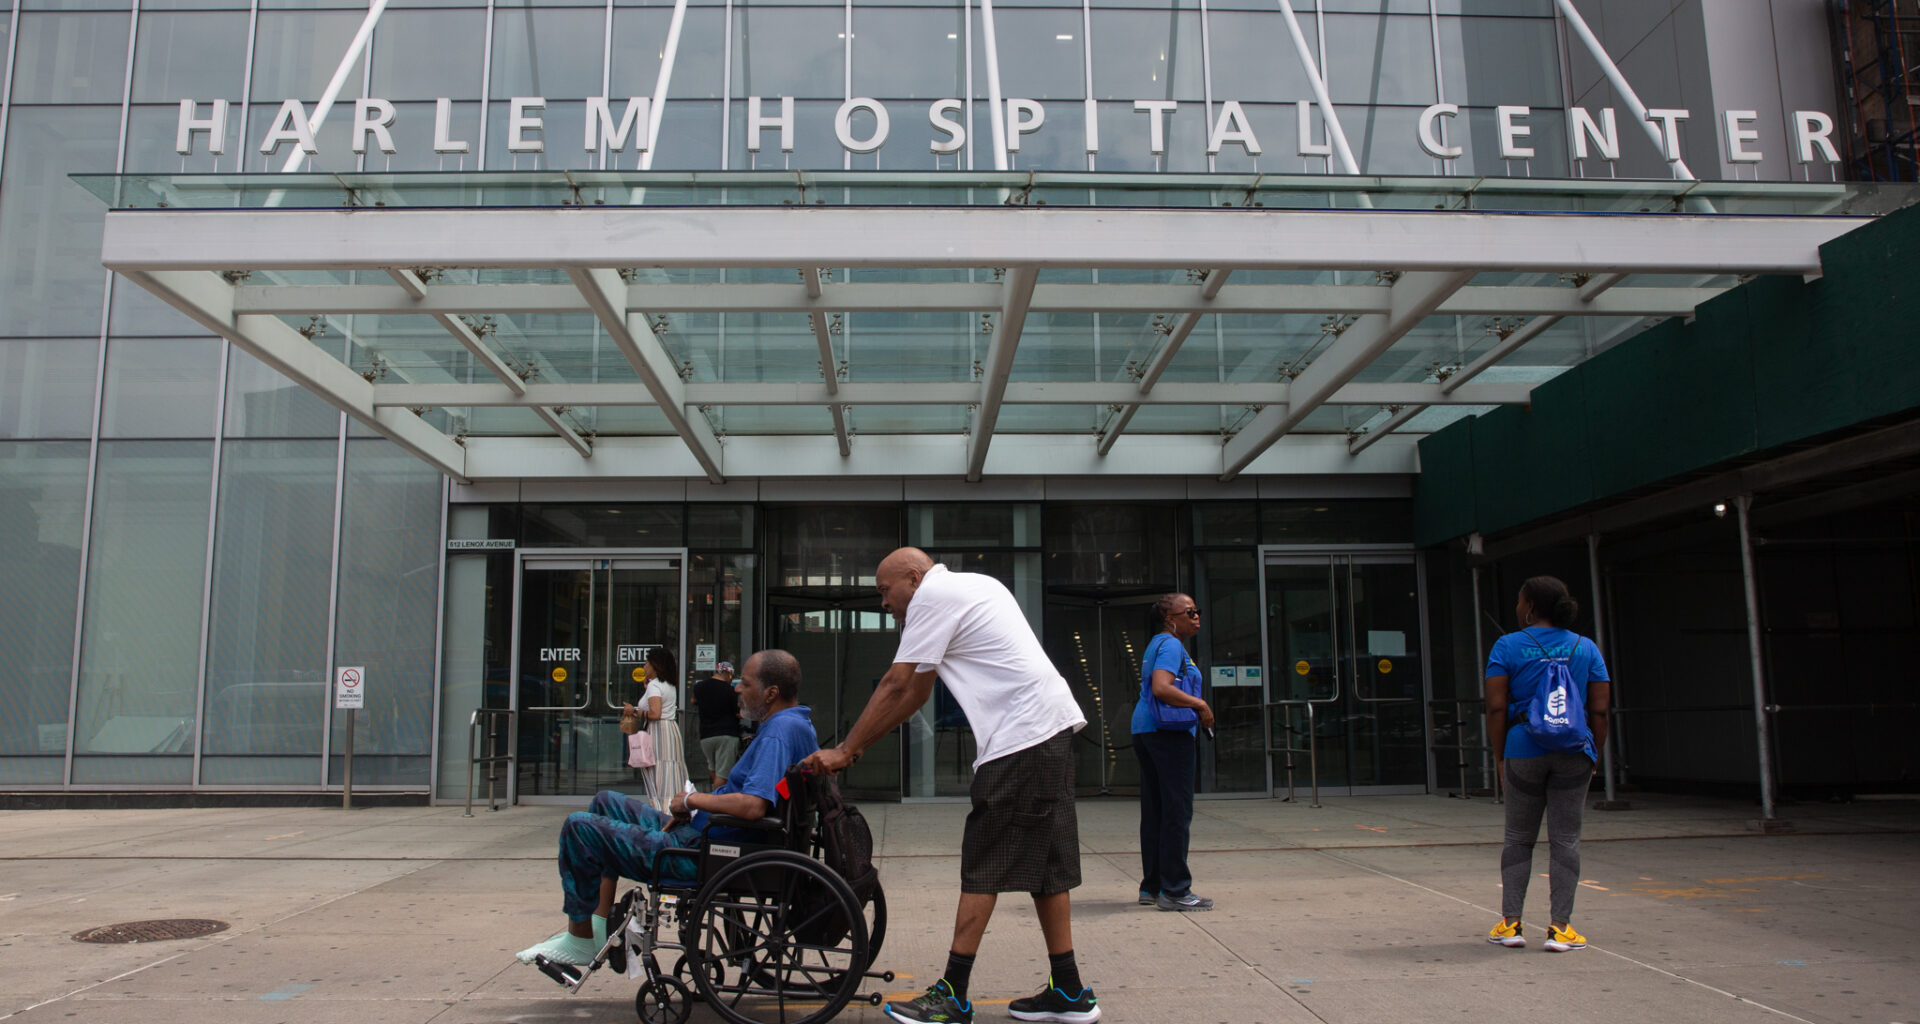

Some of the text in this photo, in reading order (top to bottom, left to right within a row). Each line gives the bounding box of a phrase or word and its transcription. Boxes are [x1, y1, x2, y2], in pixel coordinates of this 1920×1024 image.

[175, 96, 1841, 164] HARLEM HOSPITAL CENTER
[540, 648, 581, 661] ENTER
[619, 648, 651, 661] ENTE
